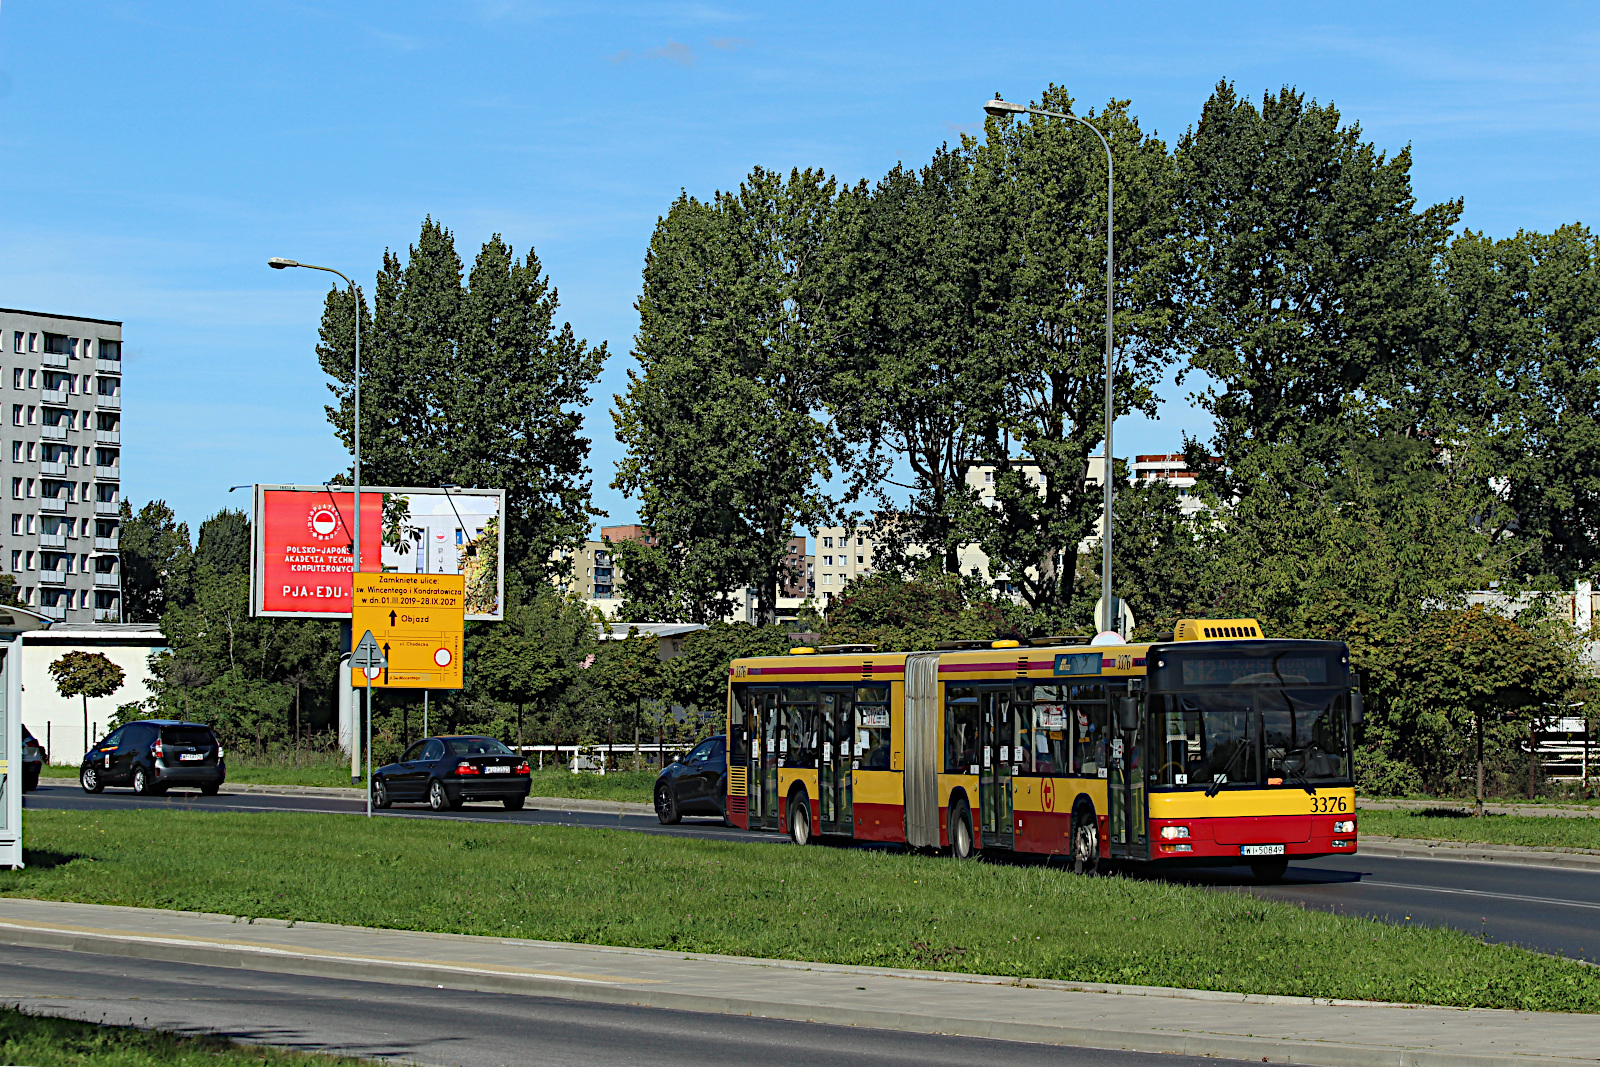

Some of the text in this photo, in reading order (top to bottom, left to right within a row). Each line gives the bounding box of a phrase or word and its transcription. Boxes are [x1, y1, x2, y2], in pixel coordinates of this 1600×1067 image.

[286, 546, 361, 554] POLSKO-JAPOŃS
[379, 576, 418, 585] Zamknięte
[283, 586, 353, 598] PJA.EDU.
[368, 586, 407, 595] Wincentego
[401, 615, 429, 624] Objazd
[1117, 654, 1131, 670] 3376
[1310, 796, 1346, 812] 3376
